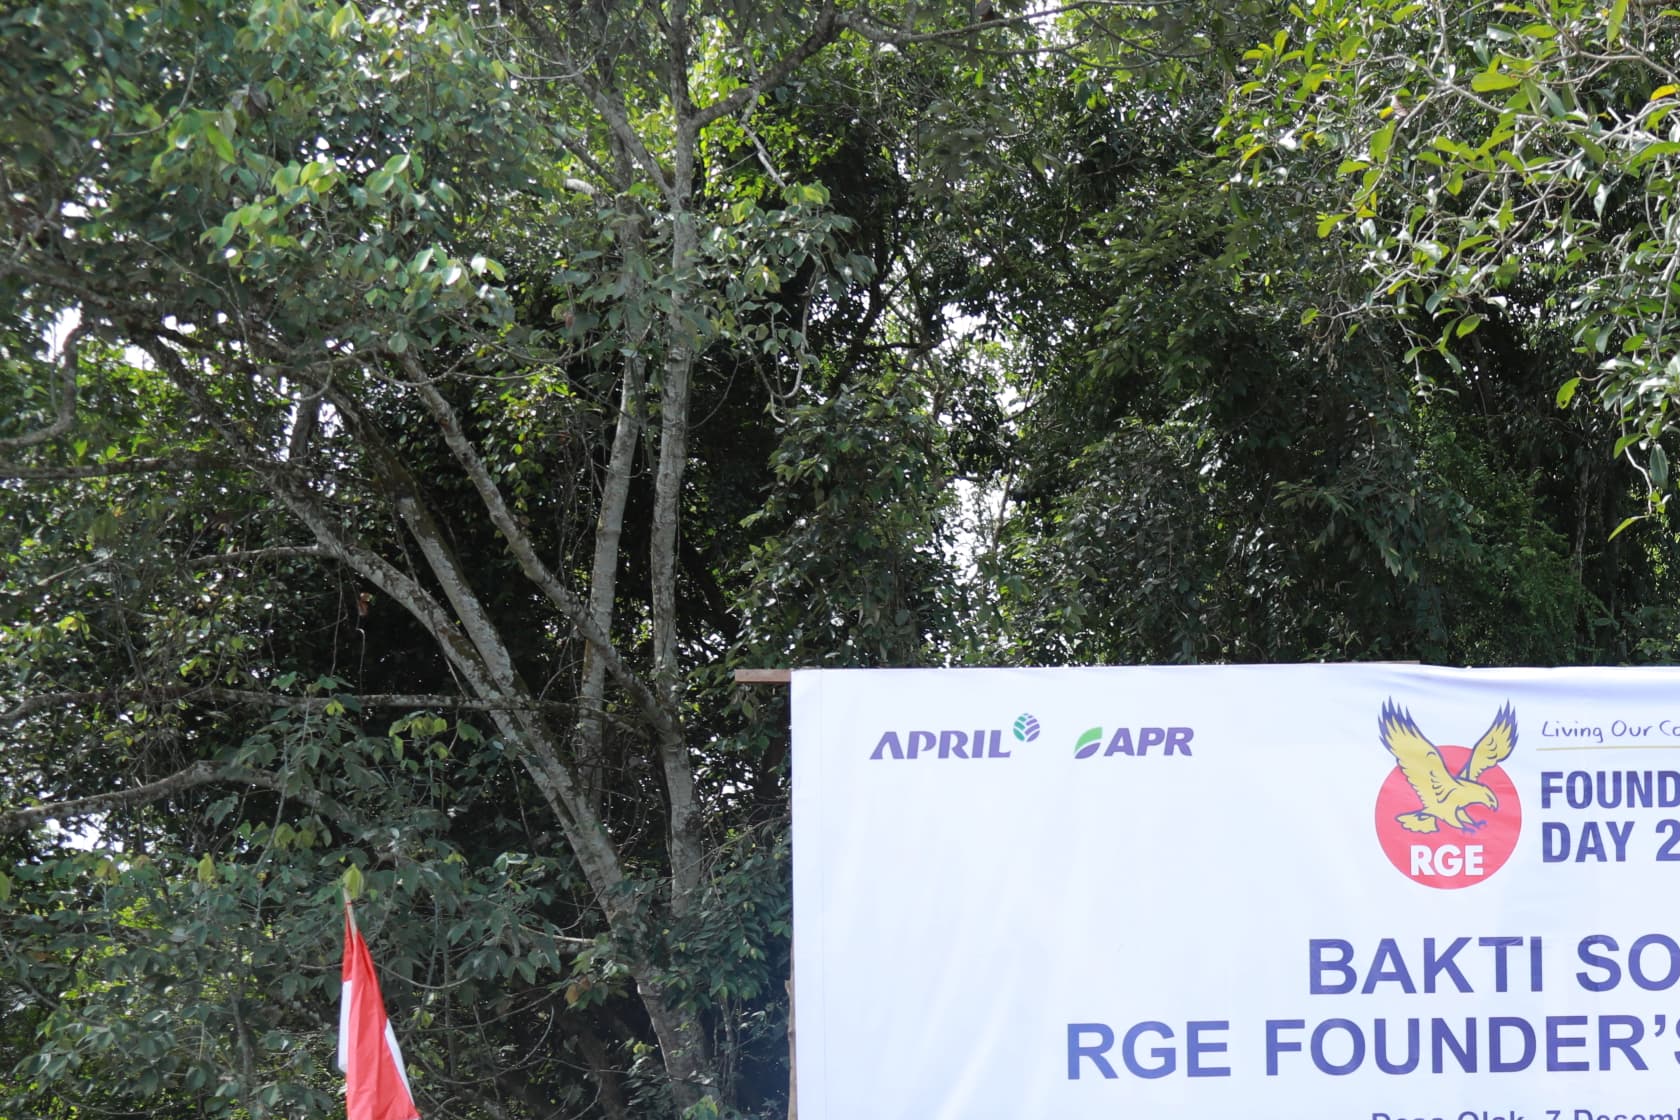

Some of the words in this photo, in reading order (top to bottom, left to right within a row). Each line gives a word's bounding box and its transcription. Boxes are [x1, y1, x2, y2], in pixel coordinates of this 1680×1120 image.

[869, 729, 1012, 760] APRIL
[1103, 727, 1195, 757] APR
[1541, 720, 1604, 743] Living
[1611, 720, 1653, 737] Our
[1541, 821, 1636, 863] DAY
[1409, 844, 1484, 877] RGE
[1308, 935, 1544, 995] BAKTI
[1066, 1019, 1232, 1080] RGE
